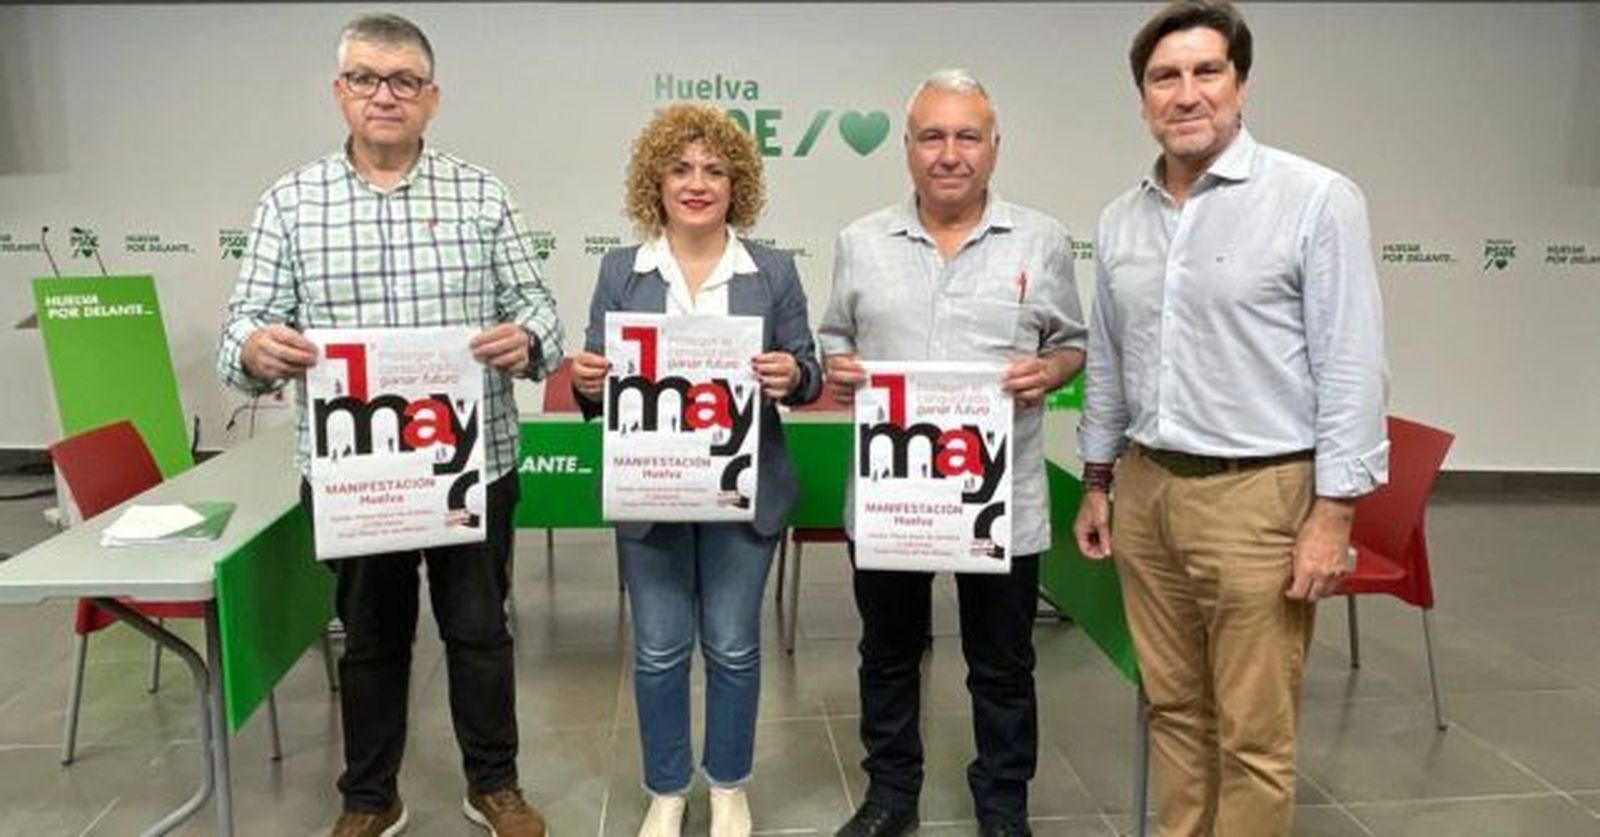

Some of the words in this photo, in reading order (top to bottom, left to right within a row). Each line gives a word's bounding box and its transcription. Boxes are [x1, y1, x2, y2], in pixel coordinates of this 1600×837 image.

[655, 74, 759, 100] Huelva
[219, 236, 248, 247] PSOE
[45, 294, 99, 307] HUELVA
[48, 308, 80, 319] POR
[518, 455, 593, 473] ANTE_
[614, 456, 711, 468] MANIFESTACIÓN
[642, 470, 682, 479] Huelva
[325, 478, 436, 495] MANIFESTACIÓN
[360, 493, 404, 505] Huelva
[865, 502, 963, 515] MANIFESTACIÓN
[894, 516, 934, 526] Huelva
